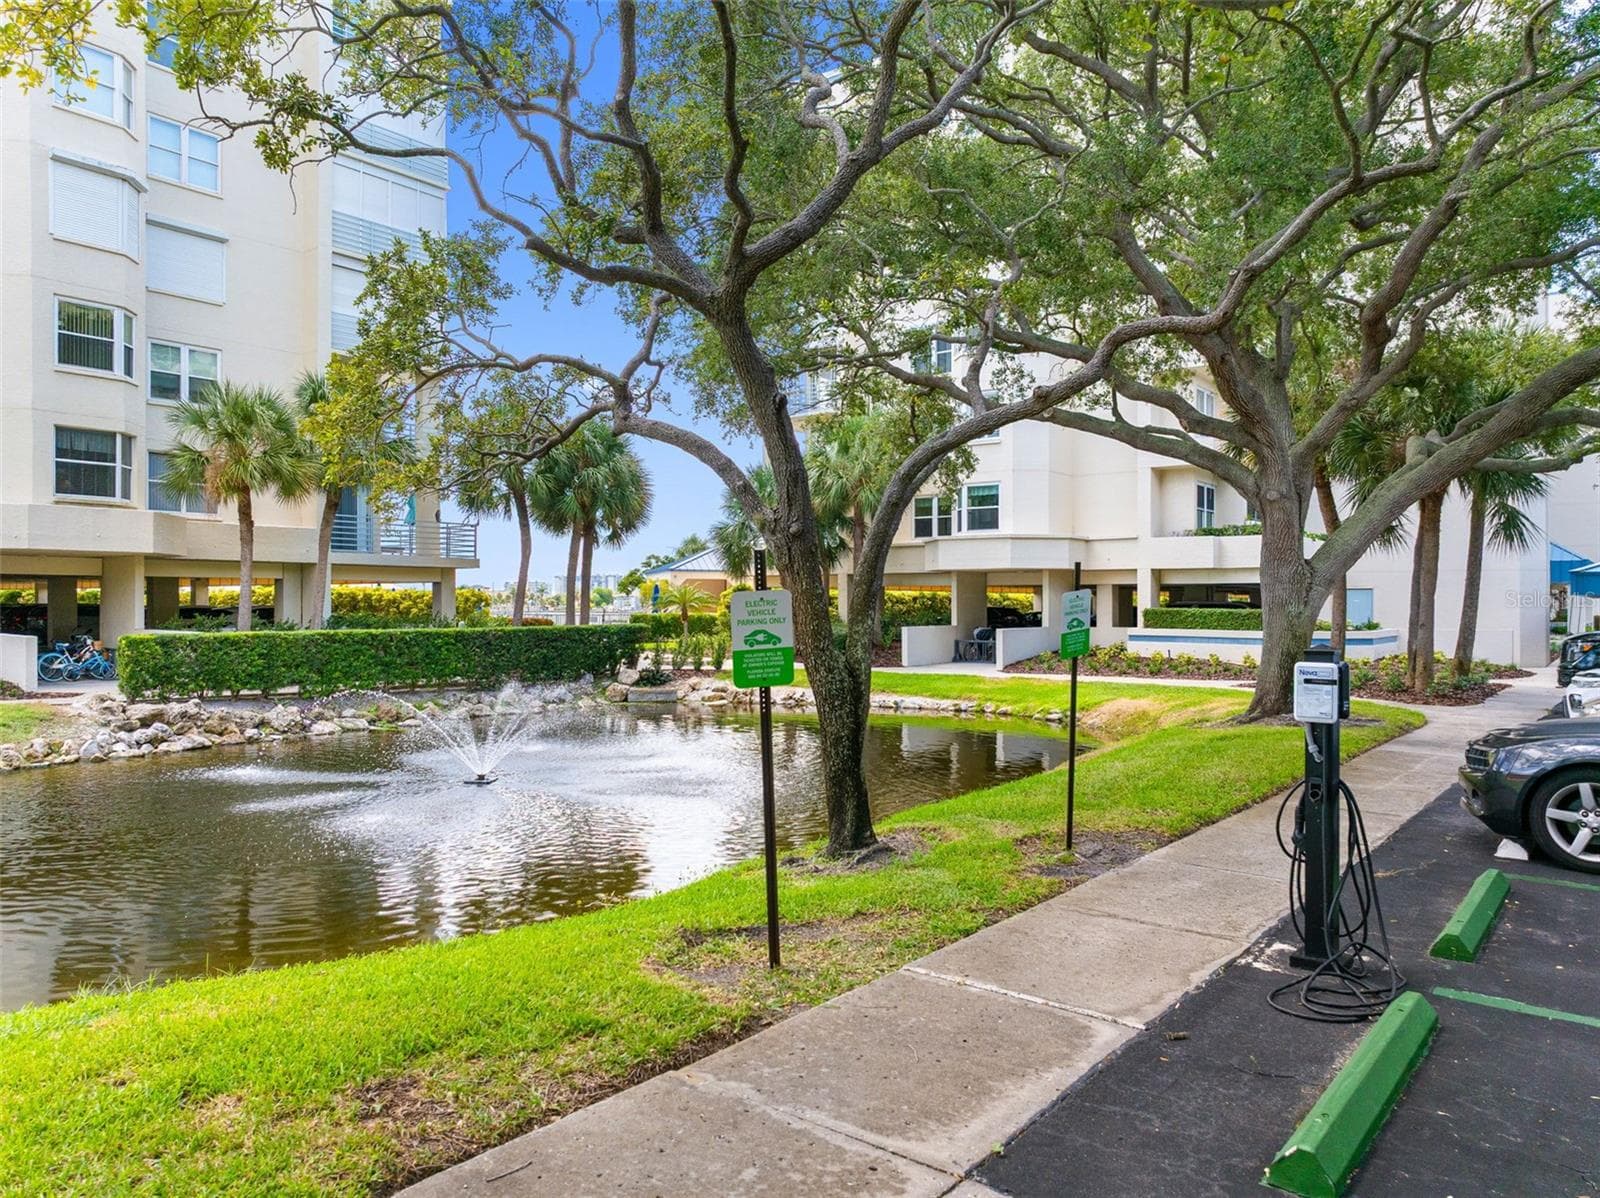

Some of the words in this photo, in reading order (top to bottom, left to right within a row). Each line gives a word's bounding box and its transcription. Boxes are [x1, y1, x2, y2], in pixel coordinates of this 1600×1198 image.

[745, 599, 778, 608] ELECTRIC
[747, 608, 776, 616] VEHICLE
[736, 618, 768, 626] PARKING
[769, 617, 786, 625] ONLY
